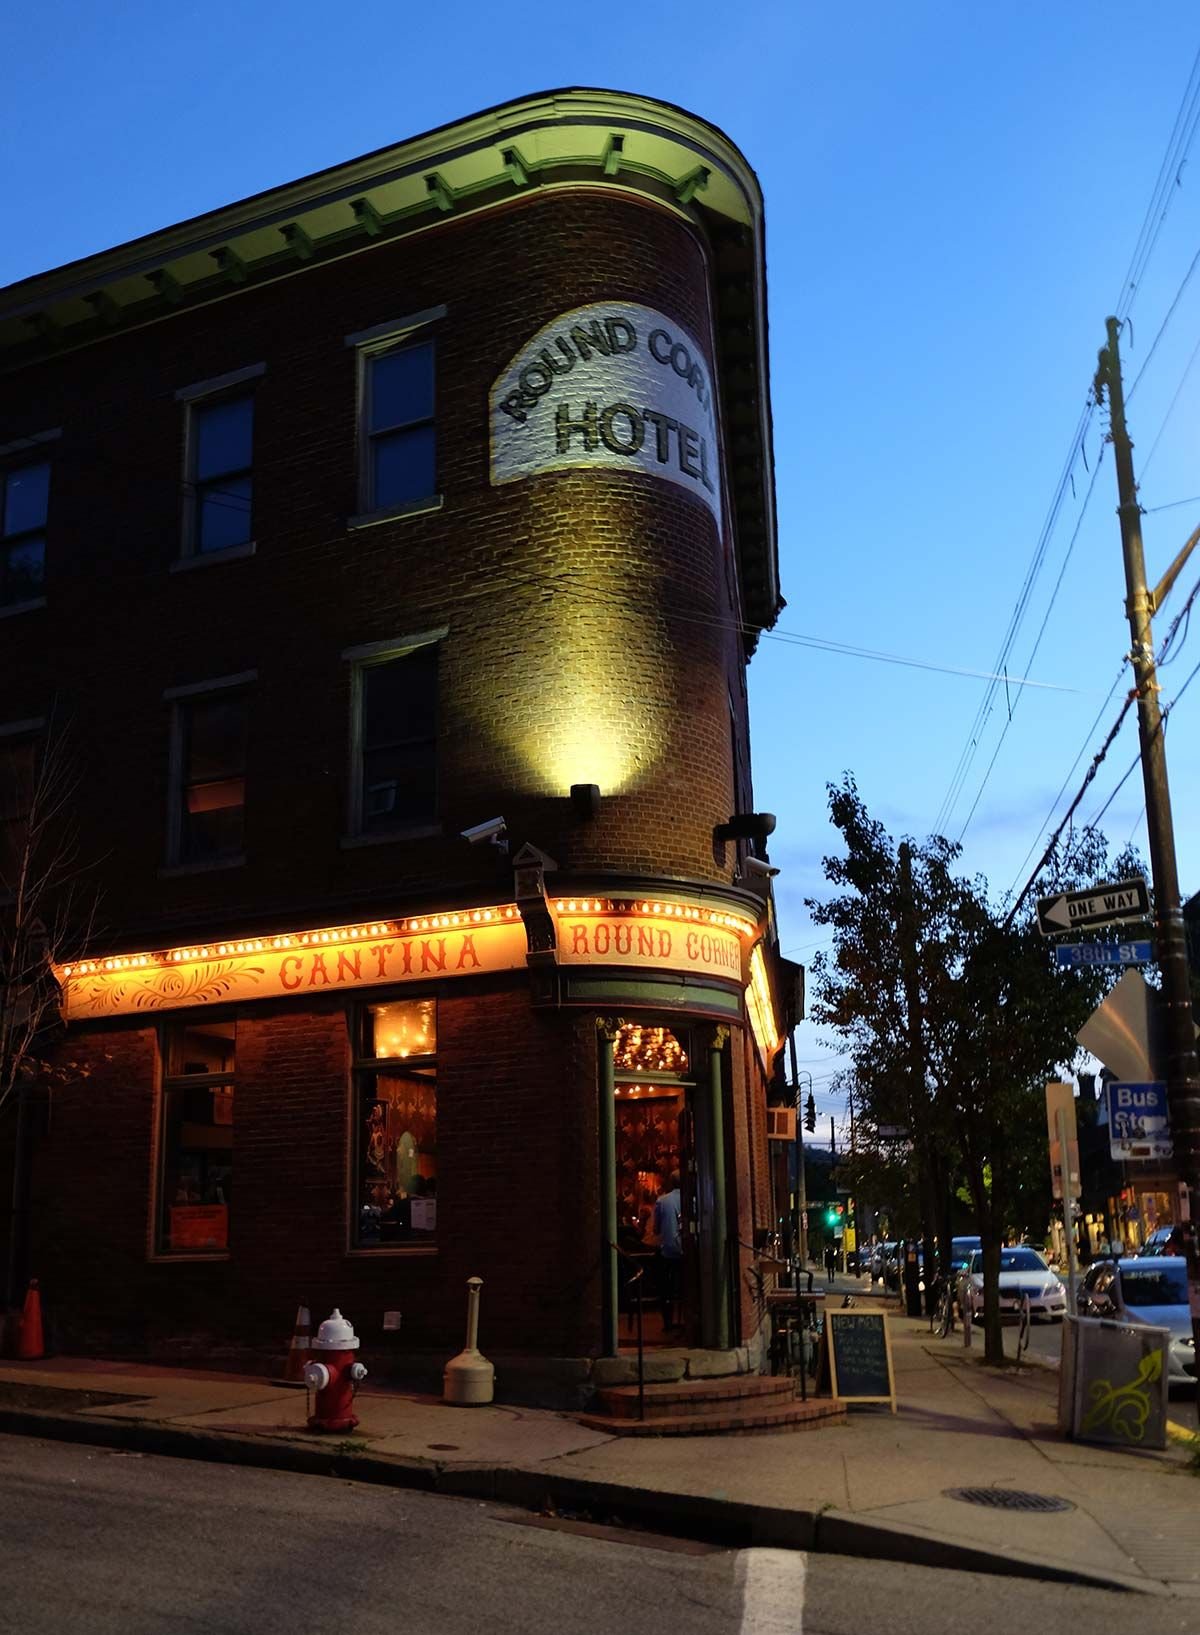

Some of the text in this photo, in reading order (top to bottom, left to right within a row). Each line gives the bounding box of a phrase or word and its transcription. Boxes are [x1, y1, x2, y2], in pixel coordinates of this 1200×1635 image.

[499, 317, 638, 424] ROUND
[556, 401, 715, 494] HOTEL
[1068, 892, 1134, 918] ONE WAY
[570, 923, 672, 958] ROUND
[1071, 945, 1138, 962] 38th St
[279, 934, 482, 990] CANTINA
[1117, 1088, 1159, 1107] Bus
[1115, 1111, 1158, 1131] Sto
